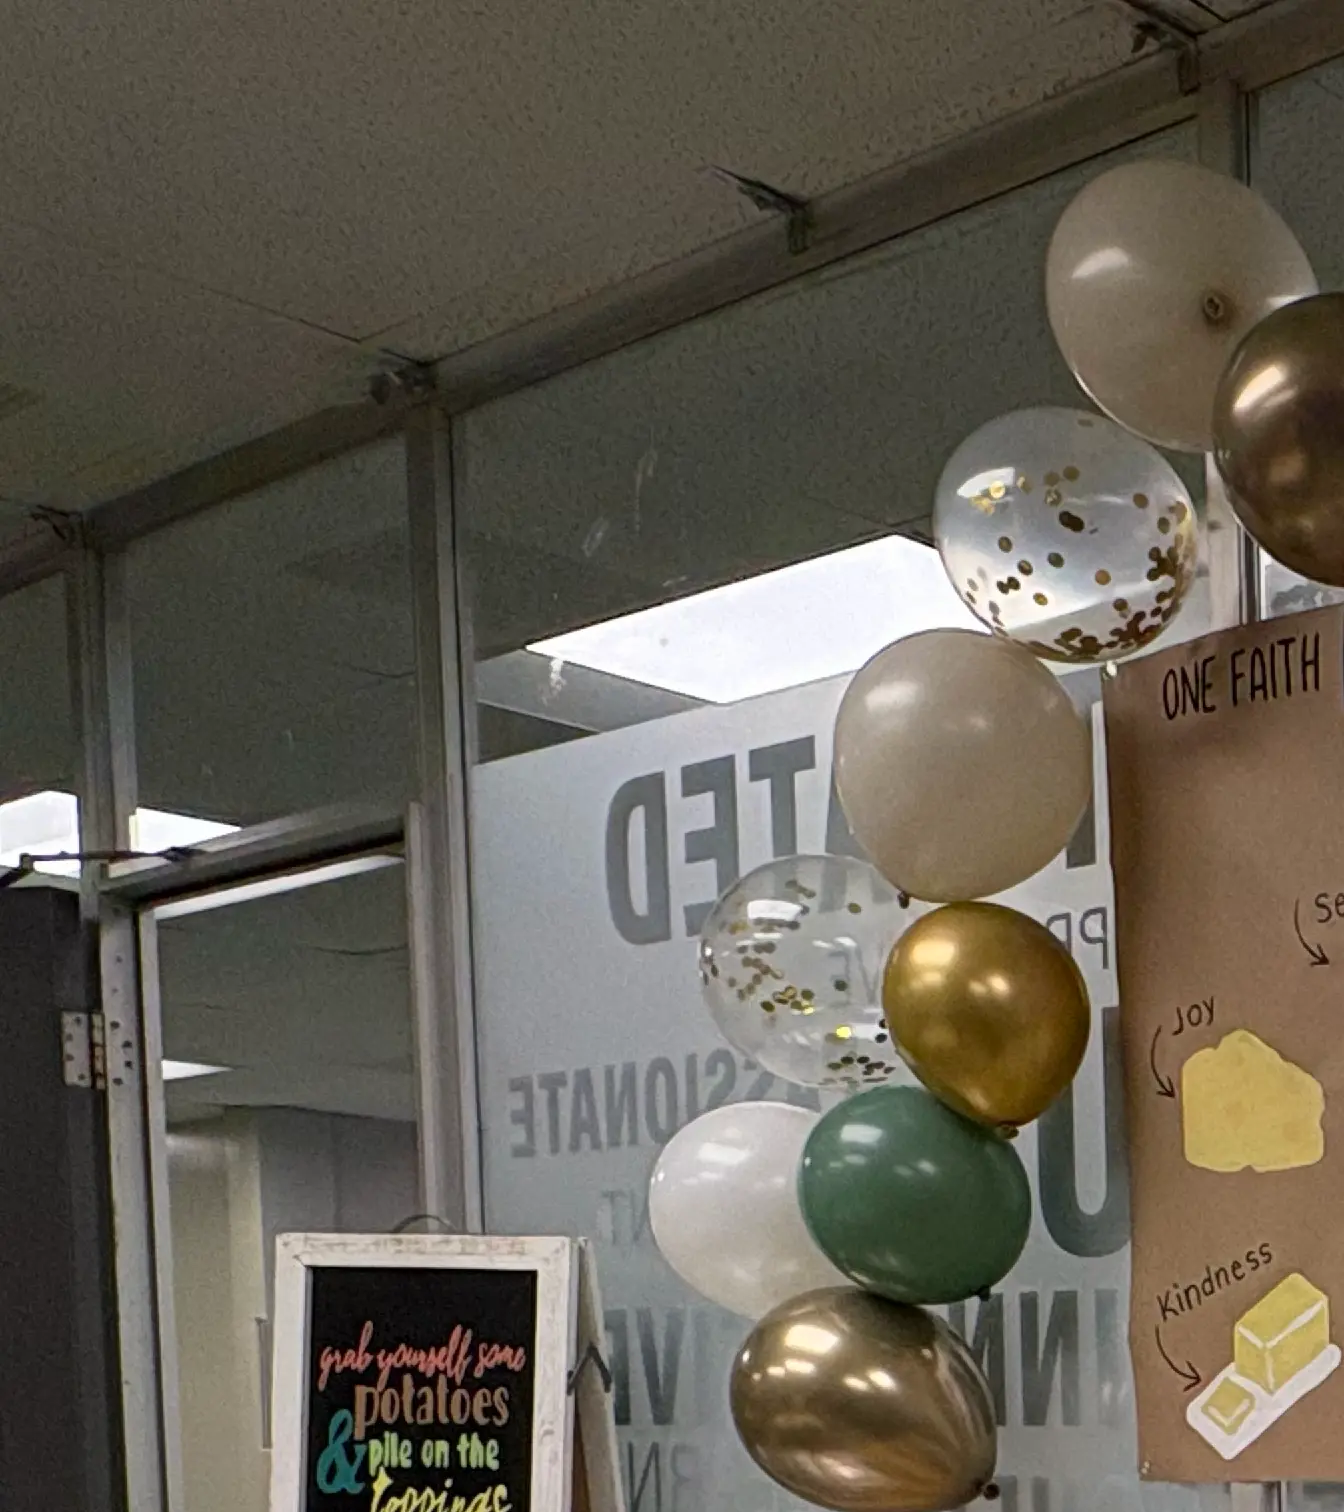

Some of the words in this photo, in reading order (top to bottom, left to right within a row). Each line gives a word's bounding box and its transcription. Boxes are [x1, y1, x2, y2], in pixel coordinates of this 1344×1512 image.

[1162, 656, 1217, 722] ONE
[1229, 632, 1320, 708] FAITH
[1156, 1242, 1273, 1323] Kindness
[318, 1320, 374, 1392] grab
[376, 1323, 473, 1393] yourself
[354, 1372, 511, 1441] potatoes
[316, 1408, 368, 1494] &
[368, 1430, 413, 1478] pile
[420, 1438, 450, 1470] on
[456, 1431, 501, 1471] the
